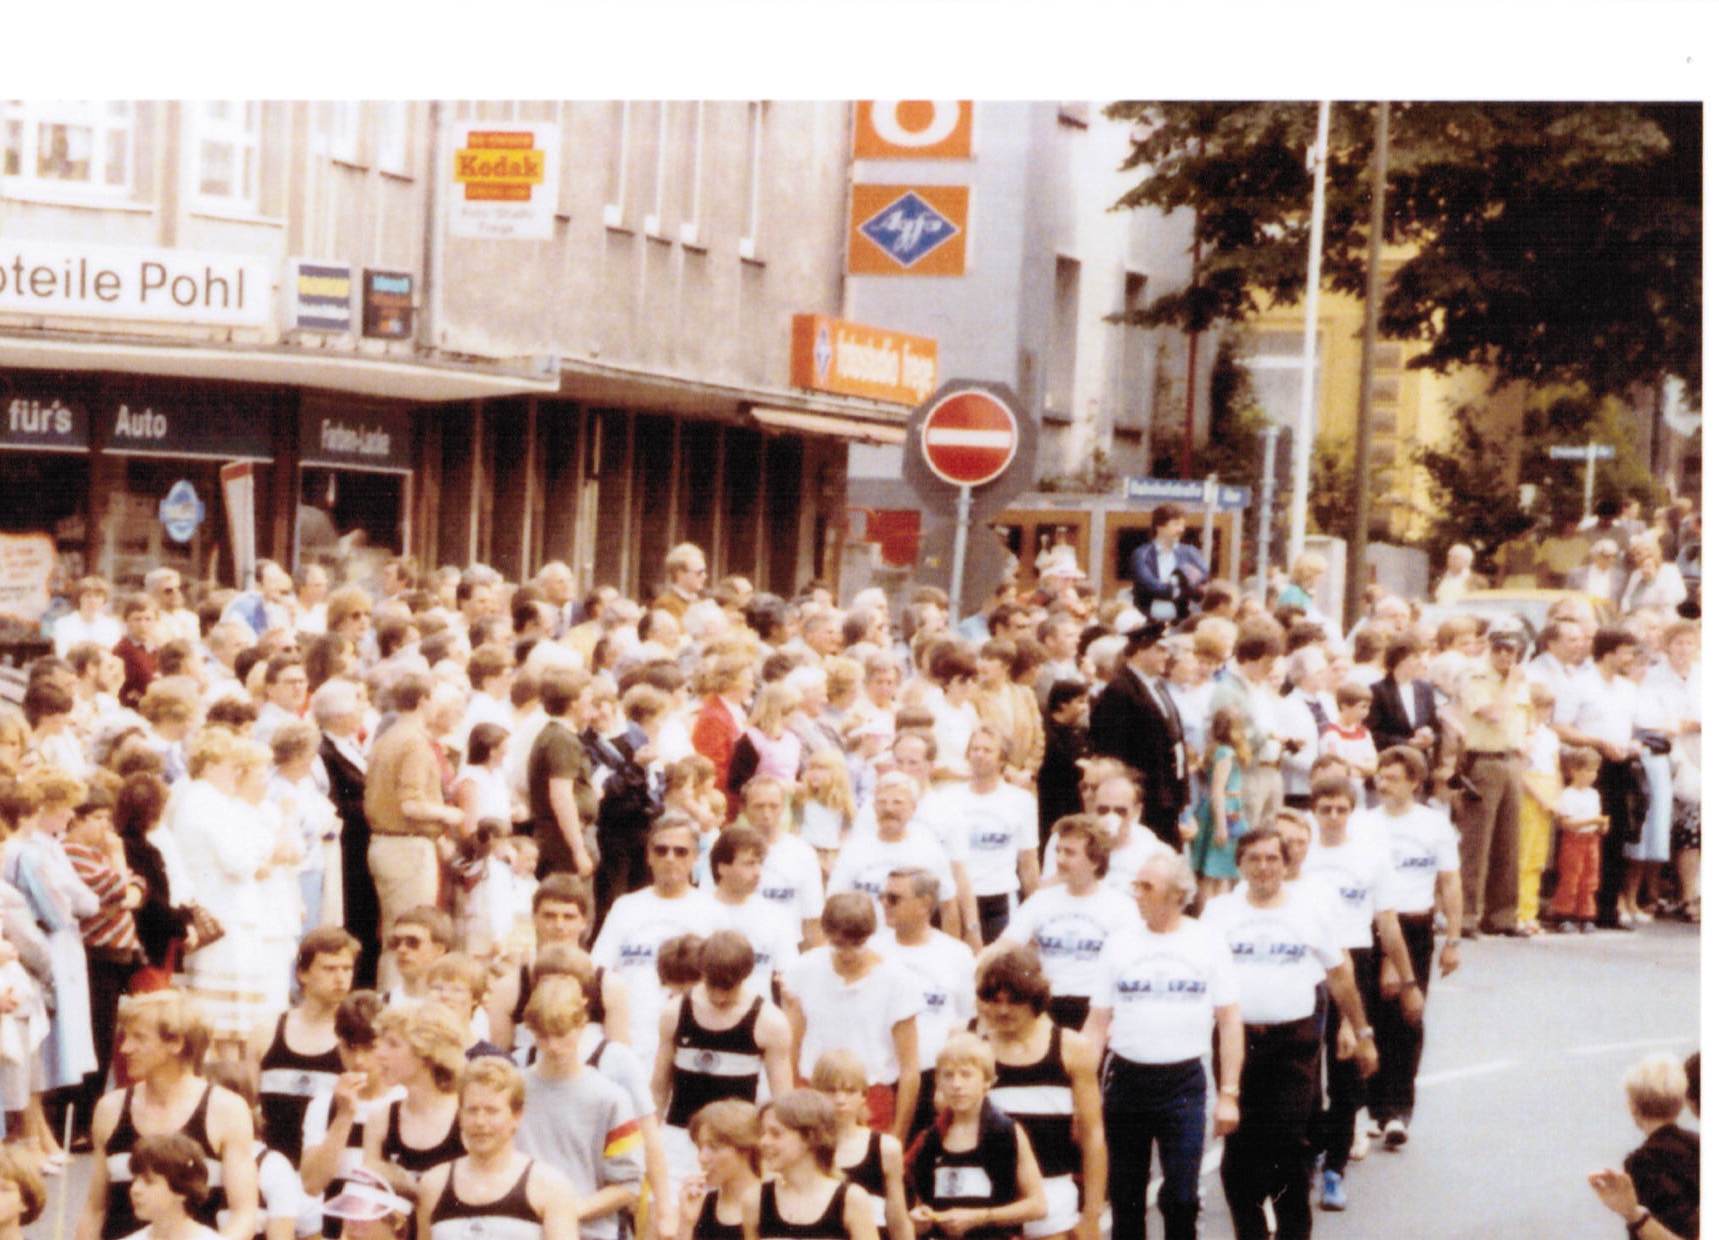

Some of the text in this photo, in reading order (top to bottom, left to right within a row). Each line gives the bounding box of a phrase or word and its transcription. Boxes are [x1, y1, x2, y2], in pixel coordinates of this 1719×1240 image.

[459, 155, 539, 178] Kodak
[868, 209, 943, 253] Agfa
[140, 261, 245, 310] Pohl
[114, 403, 168, 439] Auto
